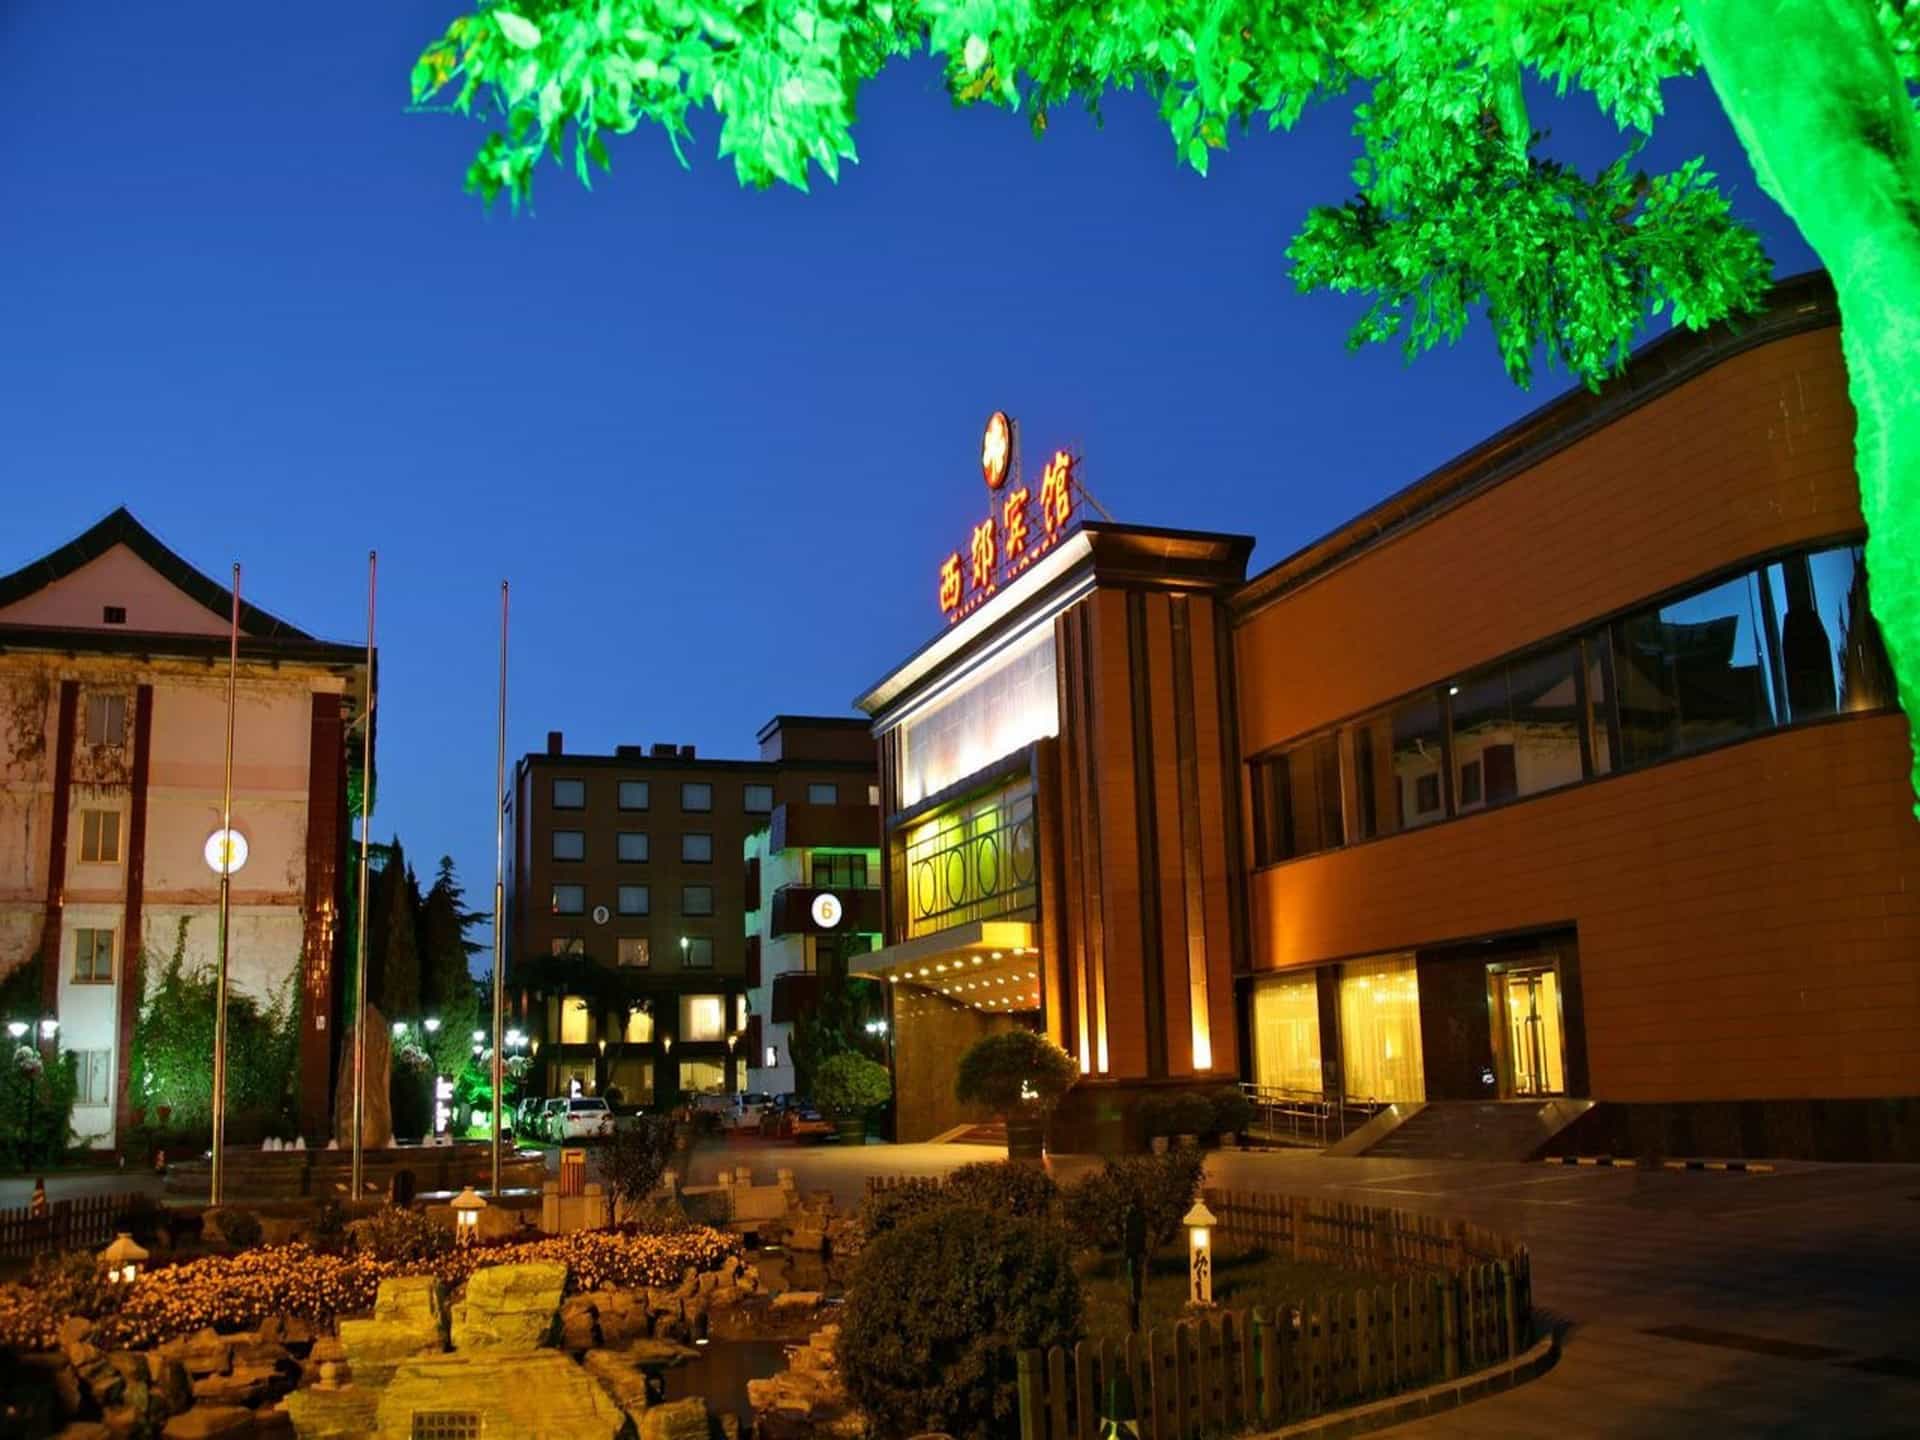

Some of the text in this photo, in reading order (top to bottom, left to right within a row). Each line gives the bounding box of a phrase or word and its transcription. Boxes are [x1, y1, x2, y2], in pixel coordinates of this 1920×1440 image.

[940, 450, 1070, 613] 西郊宾馆
[821, 901, 834, 920] 6
